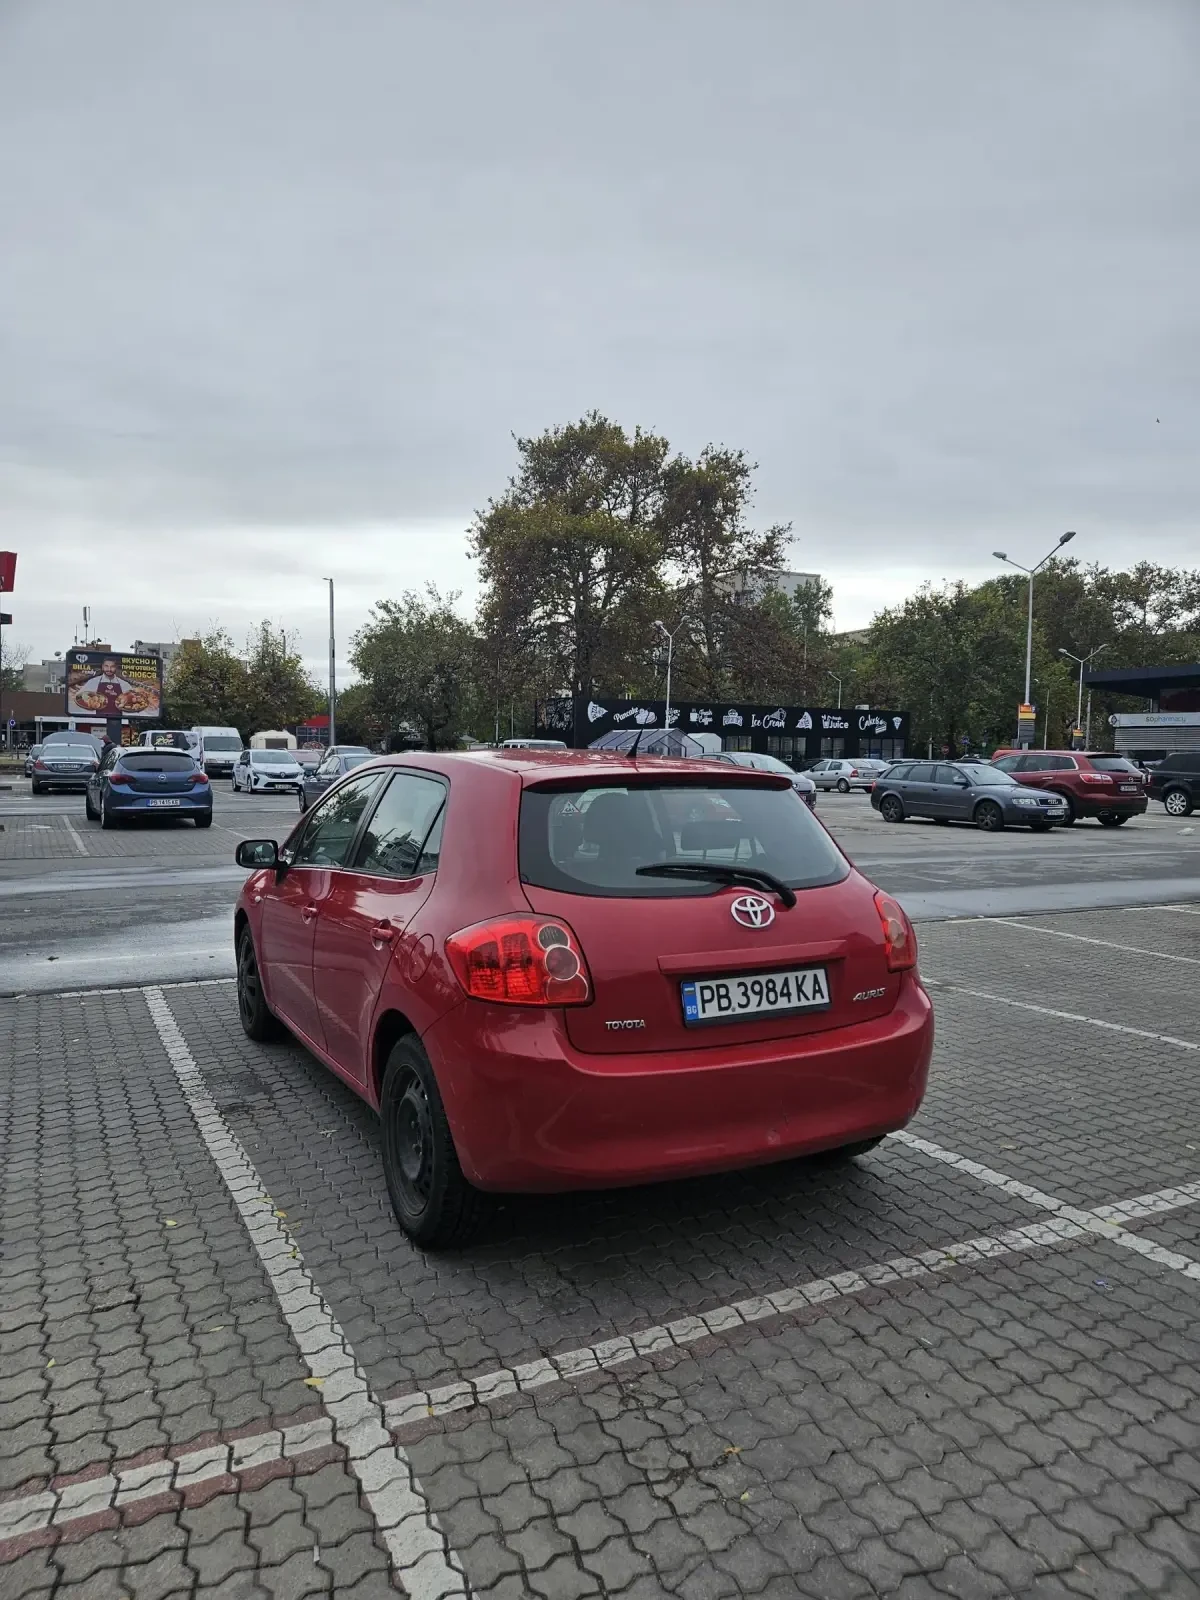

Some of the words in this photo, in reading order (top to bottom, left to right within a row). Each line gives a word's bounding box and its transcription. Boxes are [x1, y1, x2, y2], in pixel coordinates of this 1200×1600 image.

[750, 714, 762, 727] Ice
[763, 714, 785, 729] Cream
[829, 720, 849, 729] Juice
[852, 987, 886, 1001] AURIS
[686, 1005, 698, 1015] BG
[605, 1019, 646, 1031] TOYOTA
